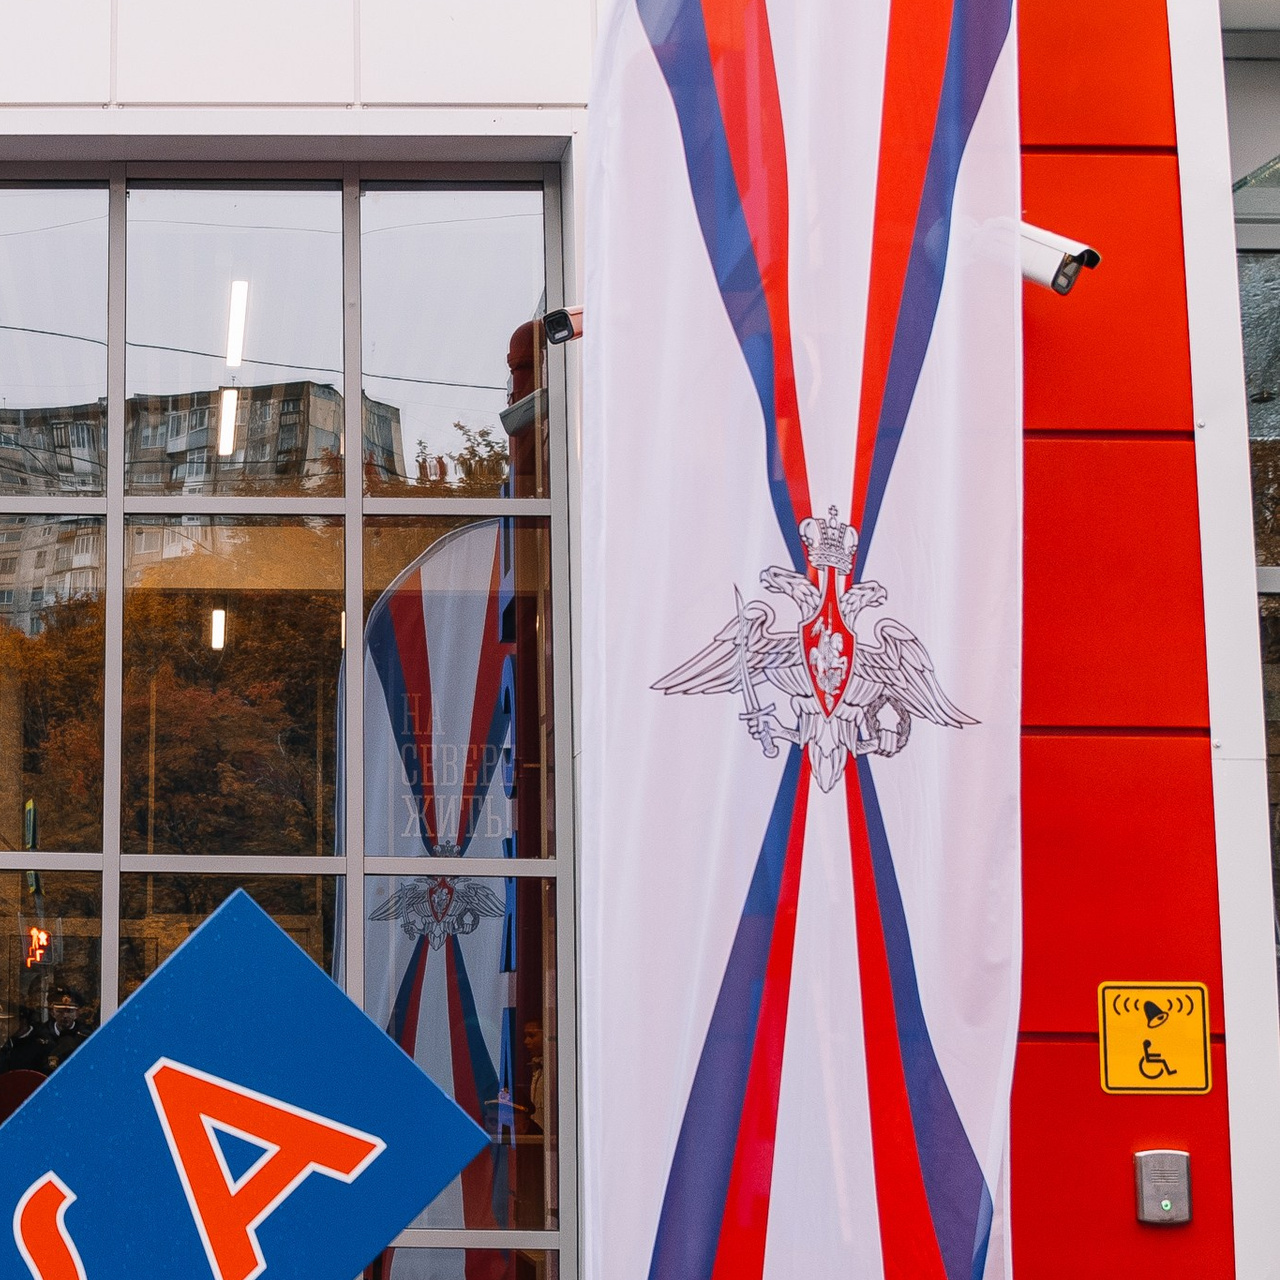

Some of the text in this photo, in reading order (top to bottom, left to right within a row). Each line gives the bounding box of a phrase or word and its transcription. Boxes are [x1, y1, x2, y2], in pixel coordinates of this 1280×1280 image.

[401, 693, 445, 735] НА
[401, 744, 516, 787] СЕВЕРЕ
[401, 795, 512, 838] ЖИТЬ!
